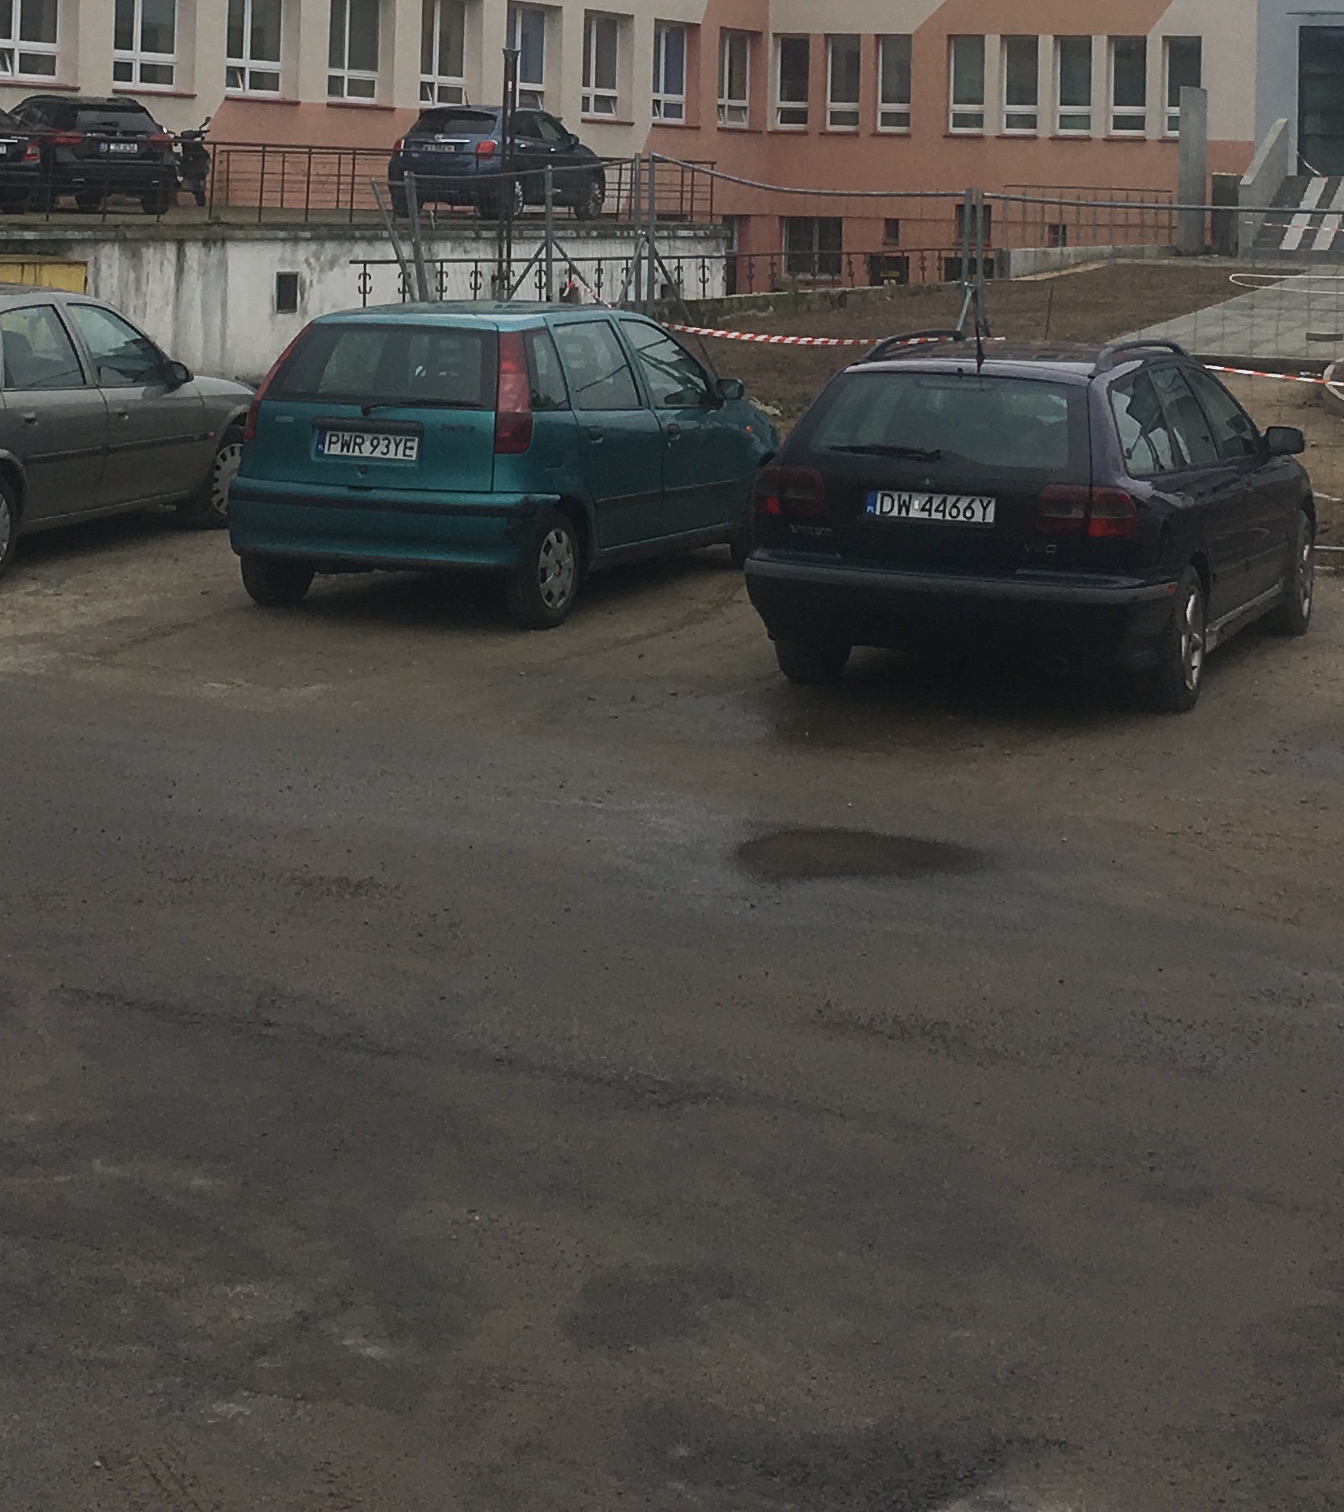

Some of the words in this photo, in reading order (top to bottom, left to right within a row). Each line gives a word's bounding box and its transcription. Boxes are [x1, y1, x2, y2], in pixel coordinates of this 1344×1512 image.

[327, 433, 364, 455] PWR
[369, 436, 416, 458] 93YE
[879, 492, 913, 517] DW
[920, 494, 992, 522] 4466Y
